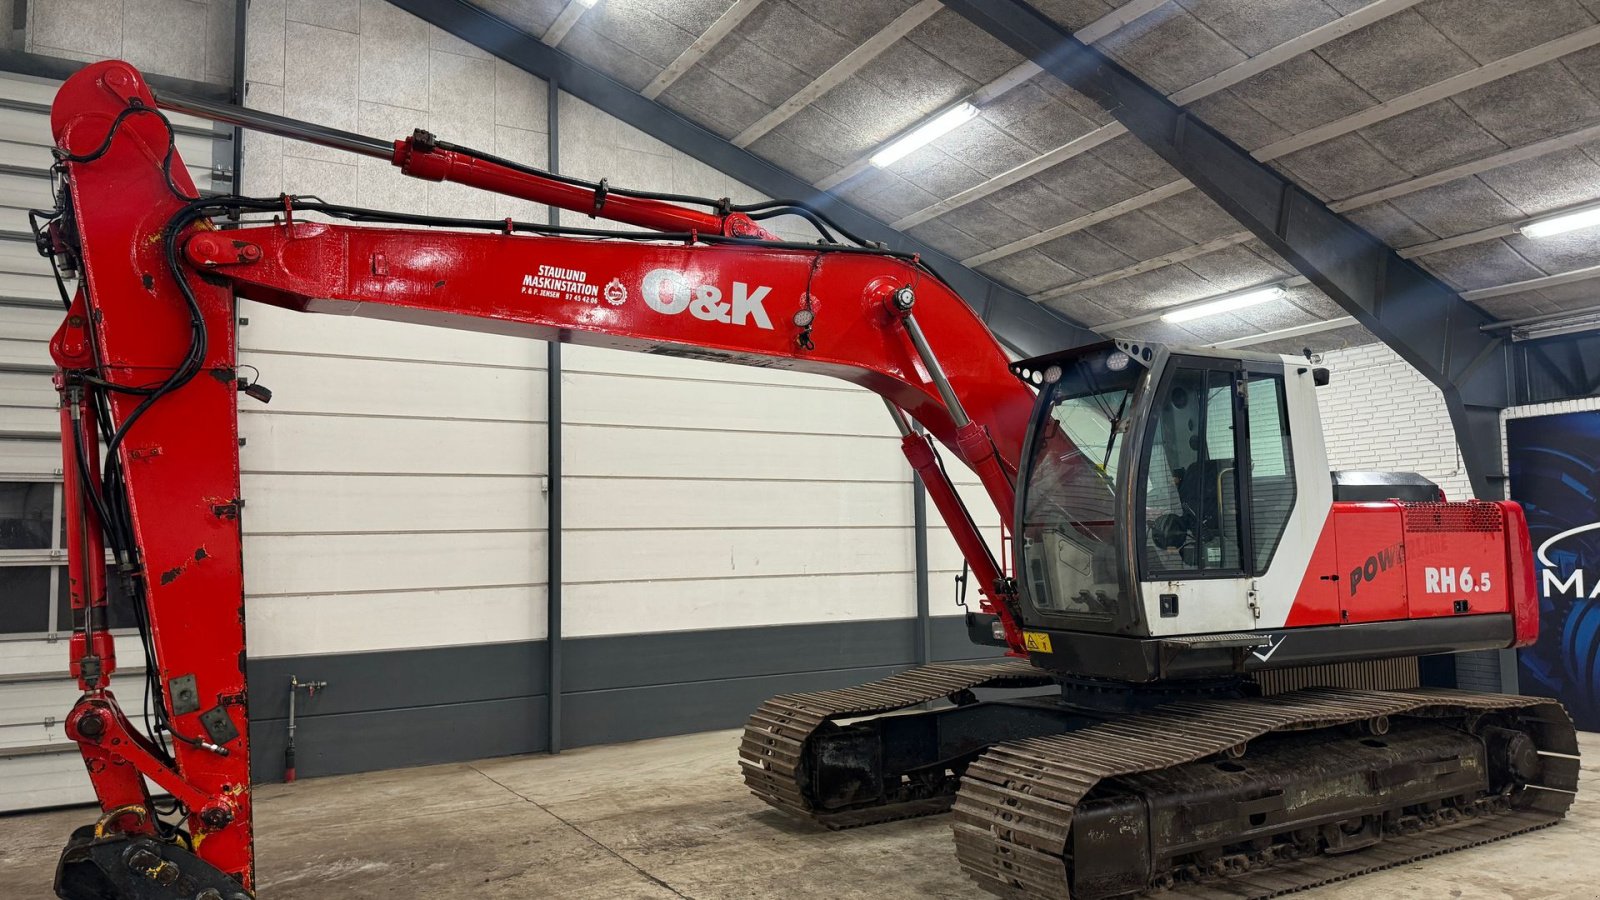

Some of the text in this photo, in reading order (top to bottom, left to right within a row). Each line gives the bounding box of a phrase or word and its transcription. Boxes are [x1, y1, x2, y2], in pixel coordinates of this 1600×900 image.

[538, 264, 587, 283] STAULUND
[522, 274, 599, 297] MASKINSTATION
[539, 289, 560, 299] JENSEN
[642, 268, 774, 331] O&K
